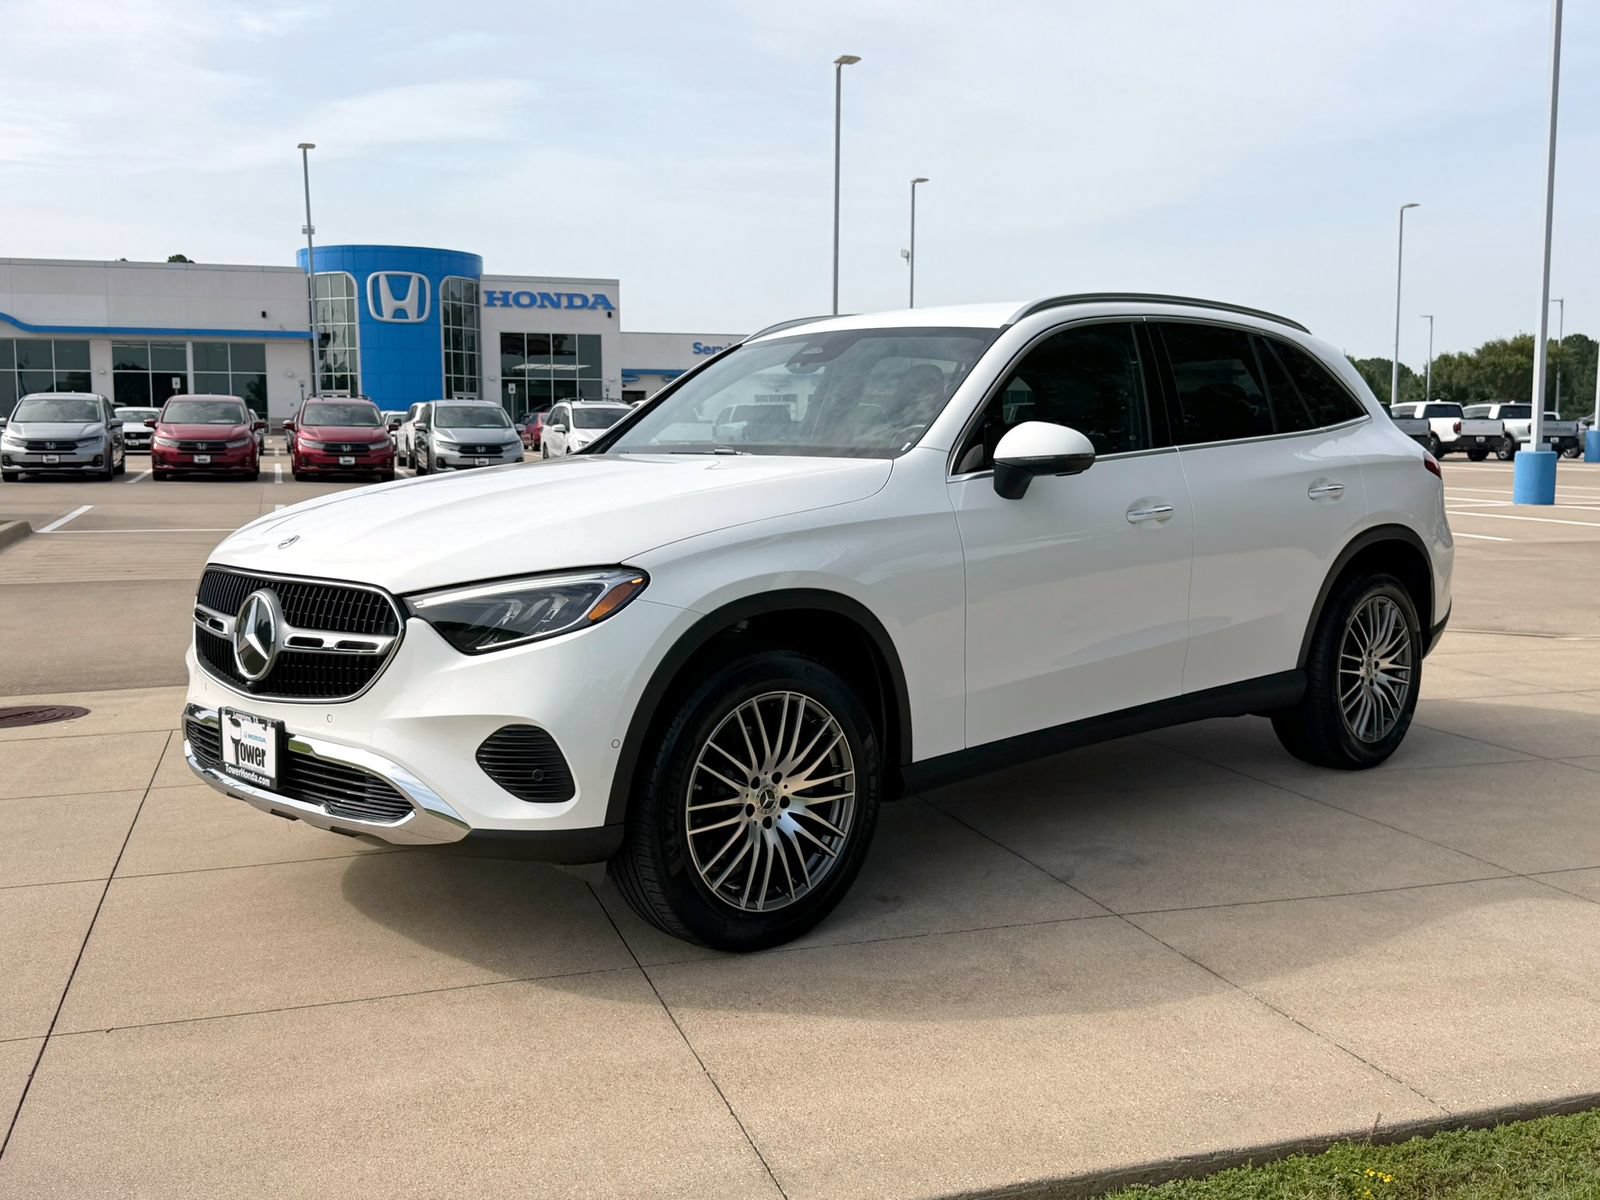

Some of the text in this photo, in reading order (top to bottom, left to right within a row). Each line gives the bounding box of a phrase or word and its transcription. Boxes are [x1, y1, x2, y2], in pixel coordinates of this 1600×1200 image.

[483, 290, 616, 310] HONDA
[231, 735, 266, 768] Tower
[225, 763, 271, 786] TowerHonda.com
